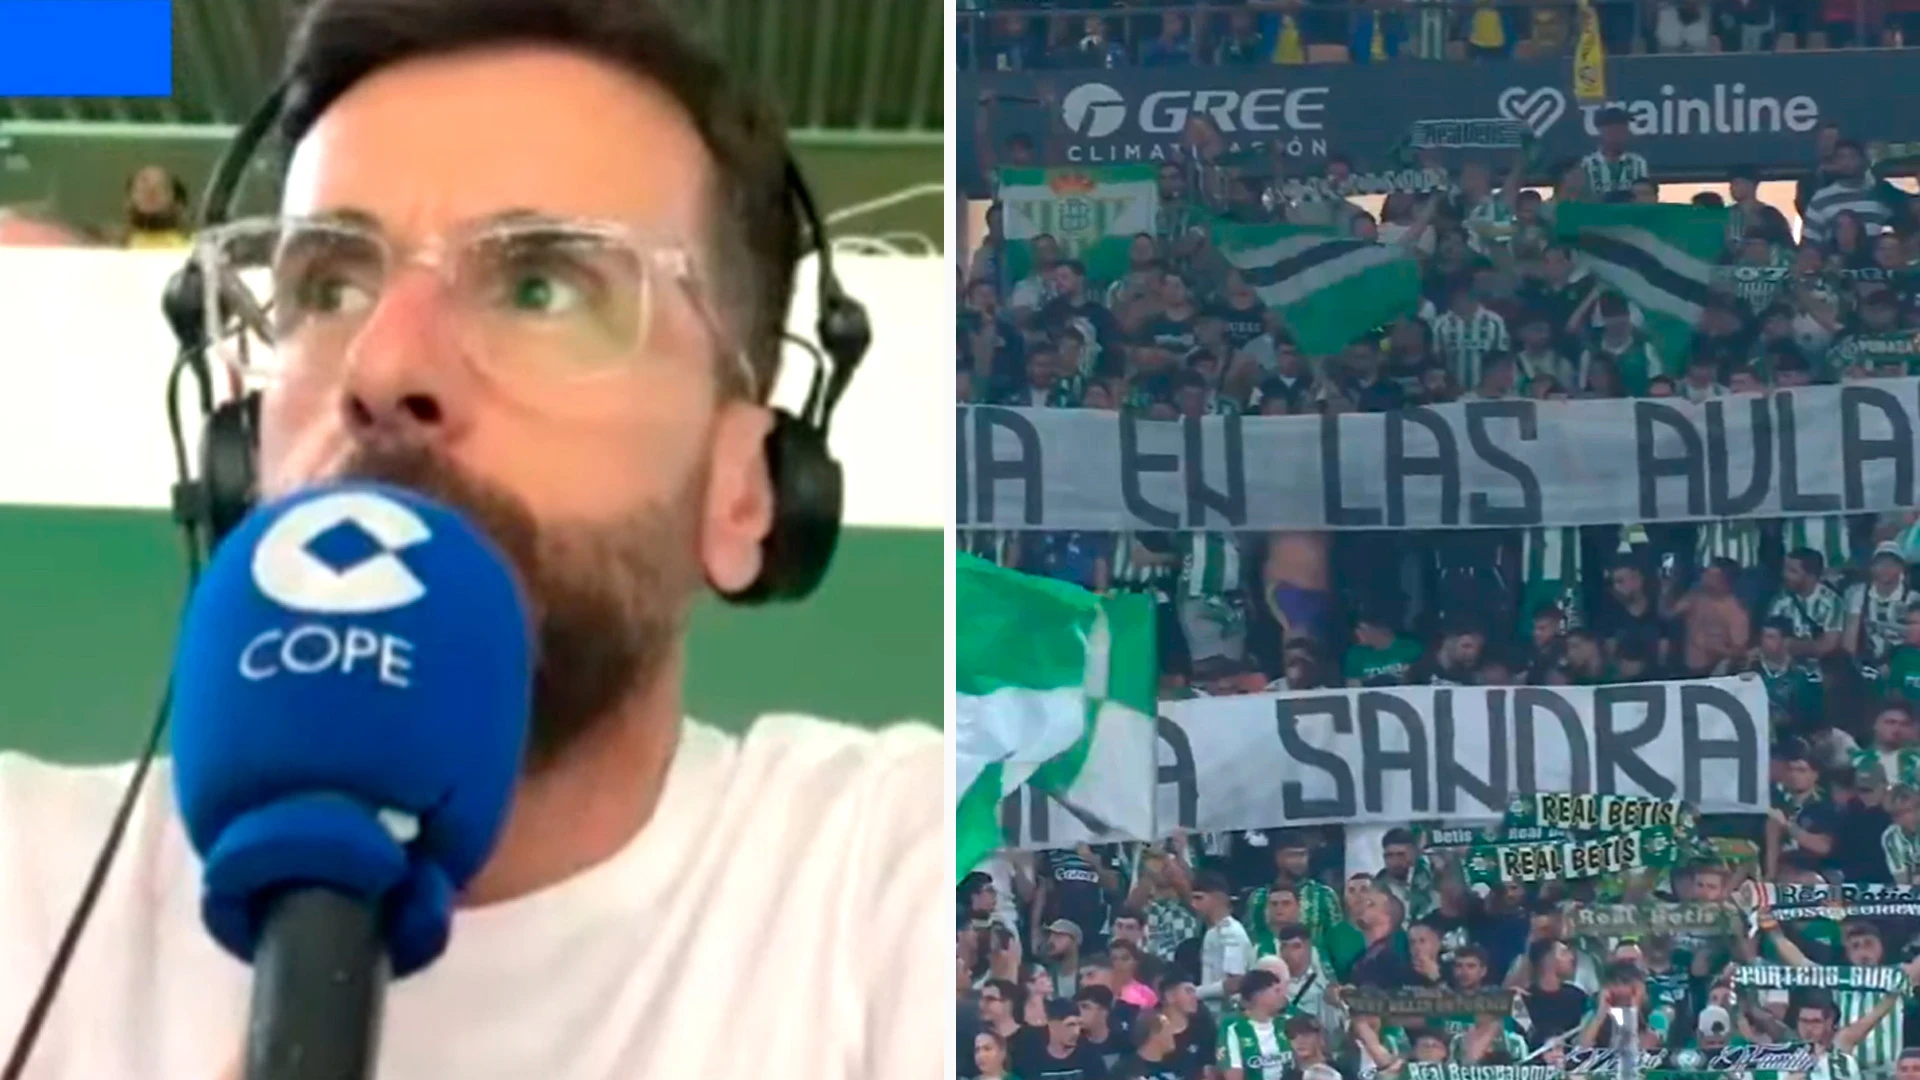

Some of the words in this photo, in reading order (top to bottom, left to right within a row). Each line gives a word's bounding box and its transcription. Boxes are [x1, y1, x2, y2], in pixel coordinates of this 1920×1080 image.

[1138, 86, 1330, 134] GREE
[1067, 136, 1328, 162] CLIMATIAÓN
[1119, 403, 1247, 529] EN
[1319, 400, 1543, 526] LAS
[1635, 385, 1920, 518] AULA
[239, 624, 416, 688] COPE
[1275, 683, 1759, 821] SANDRA
[1542, 795, 1598, 823] REAL
[1608, 799, 1674, 826] BETIS
[1432, 828, 1473, 844] Betis
[1503, 850, 1563, 876] REAL
[1571, 838, 1637, 872] BETIS
